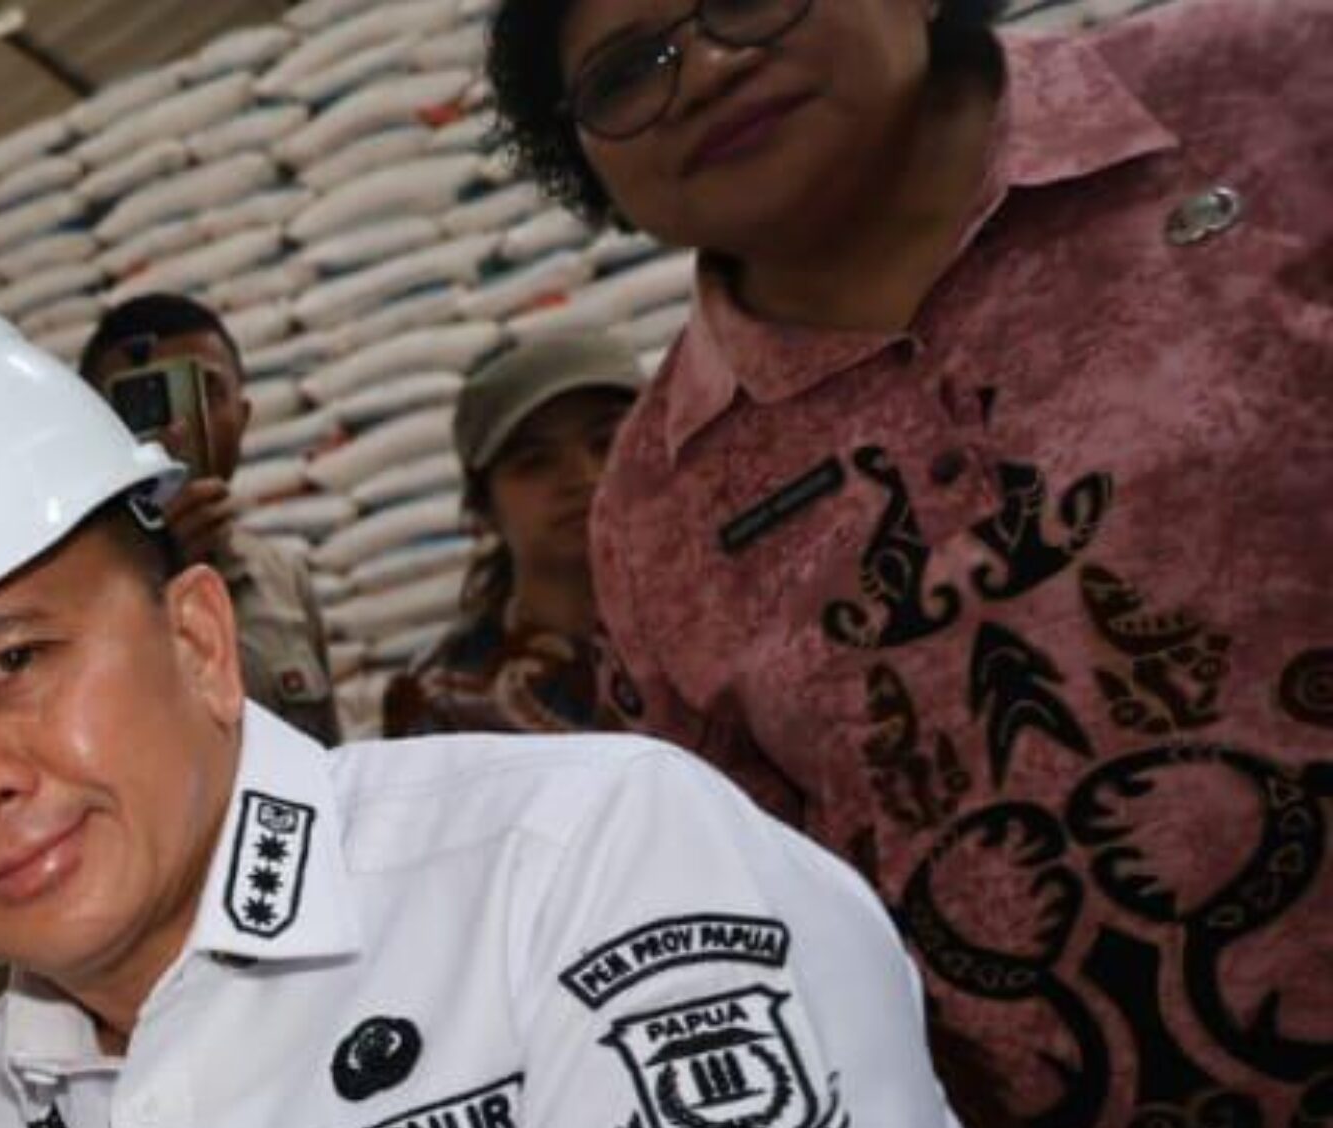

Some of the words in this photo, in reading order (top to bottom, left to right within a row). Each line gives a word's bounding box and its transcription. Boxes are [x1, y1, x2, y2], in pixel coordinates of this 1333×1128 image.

[631, 928, 694, 964] PROV
[701, 922, 776, 952] PAPUA
[646, 1000, 749, 1044] PAPUA
